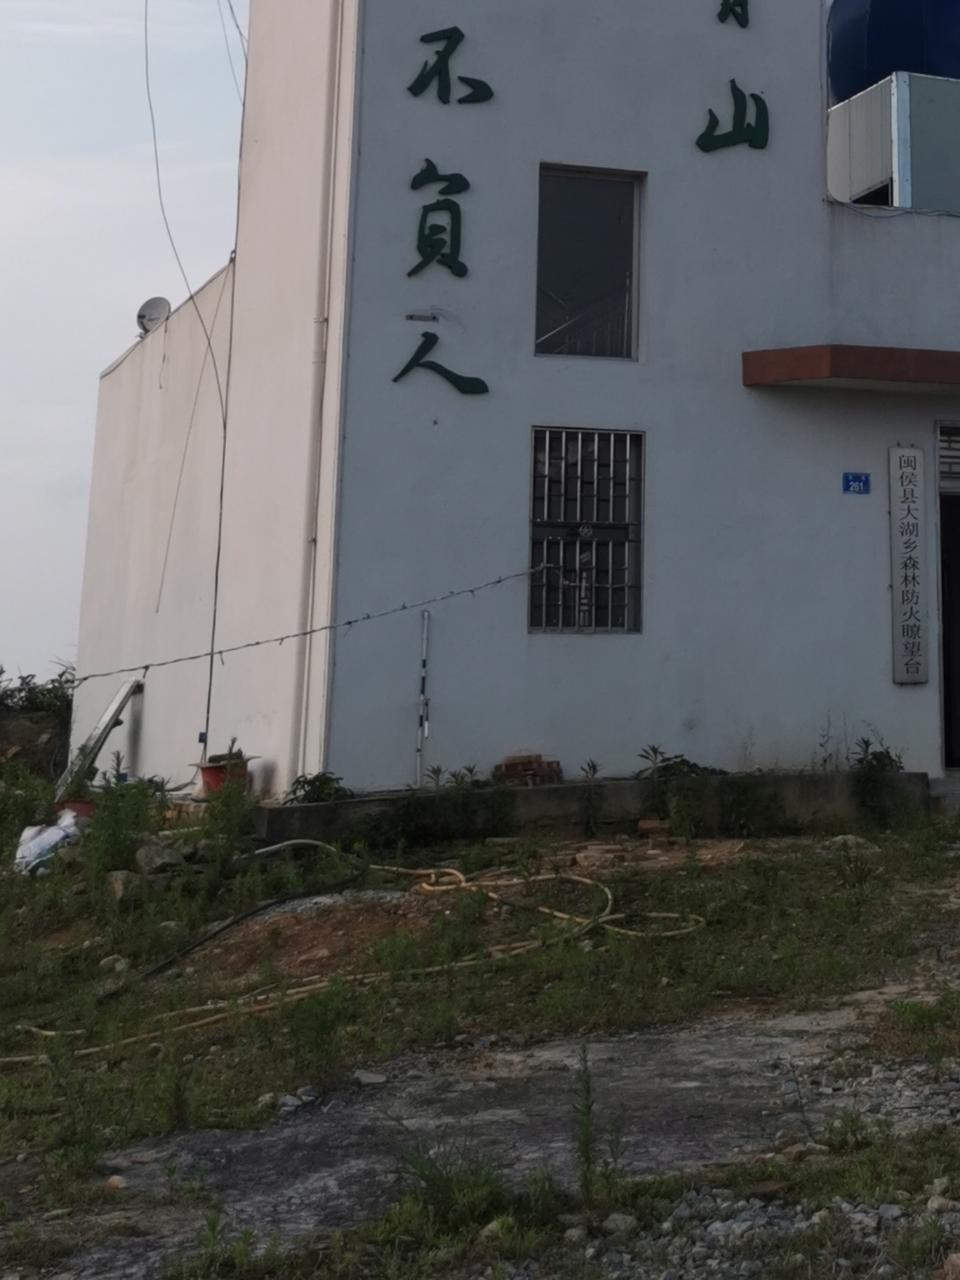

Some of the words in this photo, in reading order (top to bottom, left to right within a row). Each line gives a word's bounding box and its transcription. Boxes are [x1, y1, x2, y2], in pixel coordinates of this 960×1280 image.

[898, 453, 922, 675] 闽侯县大湖乡森林防火瞭望台
